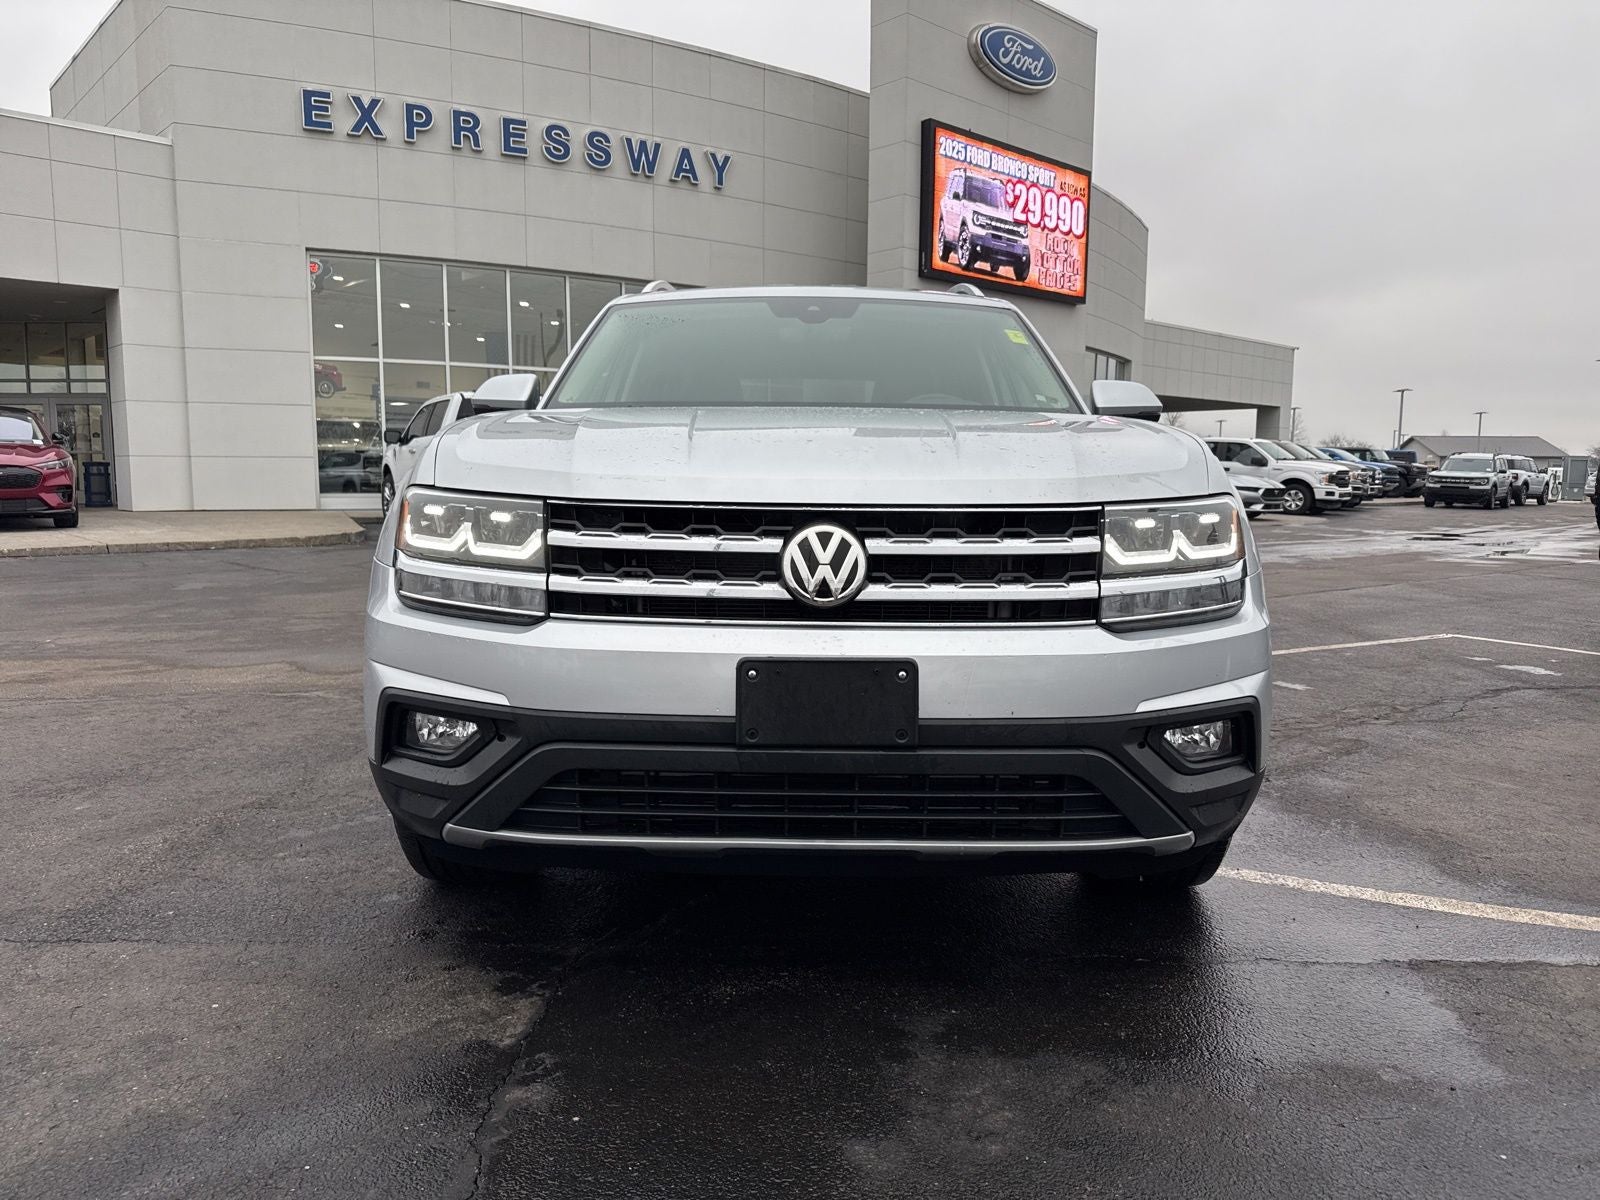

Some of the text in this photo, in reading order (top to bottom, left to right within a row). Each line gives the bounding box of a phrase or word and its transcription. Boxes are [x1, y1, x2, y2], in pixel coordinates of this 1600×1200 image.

[999, 34, 1045, 78] Ford
[301, 87, 733, 190] EXPRESSWAY
[939, 136, 1056, 188] 2025 FORD BRONCO SPORT
[1005, 180, 1086, 237] $29,990
[1038, 268, 1078, 291] PRICES
